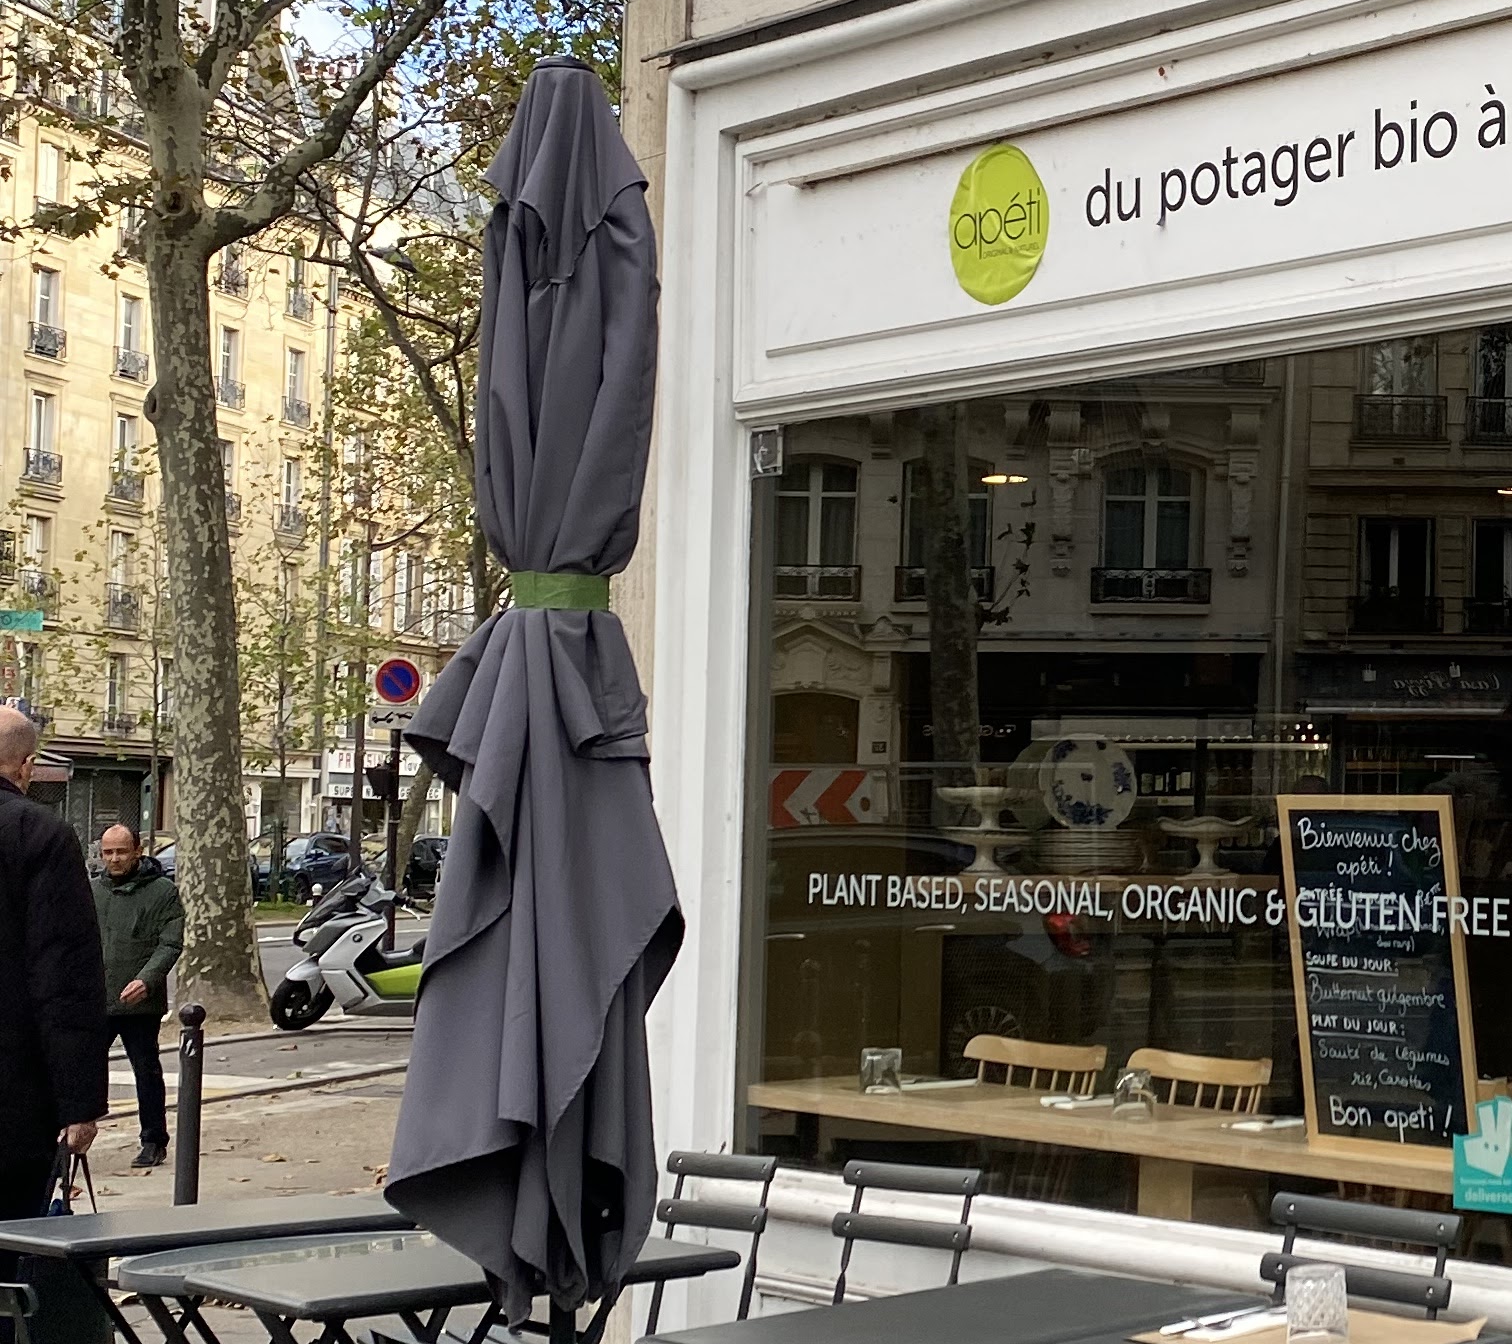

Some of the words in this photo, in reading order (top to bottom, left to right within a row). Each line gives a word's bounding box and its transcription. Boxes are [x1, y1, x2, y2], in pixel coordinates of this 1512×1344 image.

[1087, 168, 1141, 227] du
[1157, 131, 1355, 228] potager
[1375, 100, 1458, 171] bio
[1478, 84, 1506, 149] à
[954, 187, 1041, 260] apéti
[1298, 817, 1399, 850] Bienvenue
[1337, 855, 1382, 883] apéti
[808, 873, 882, 906] PLANT
[886, 875, 967, 914] BASED,
[974, 878, 1113, 921] SEASONAL,
[1122, 883, 1257, 925] ORGANIC
[1265, 889, 1286, 925] &
[1294, 892, 1422, 933] GLUTEN
[1433, 896, 1510, 937] FREE
[1306, 951, 1338, 967] SOUPE
[1343, 954, 1358, 968] DU
[1312, 1015, 1337, 1028] PLAT
[1344, 1017, 1360, 1030] DU
[1329, 1095, 1371, 1127] Bon
